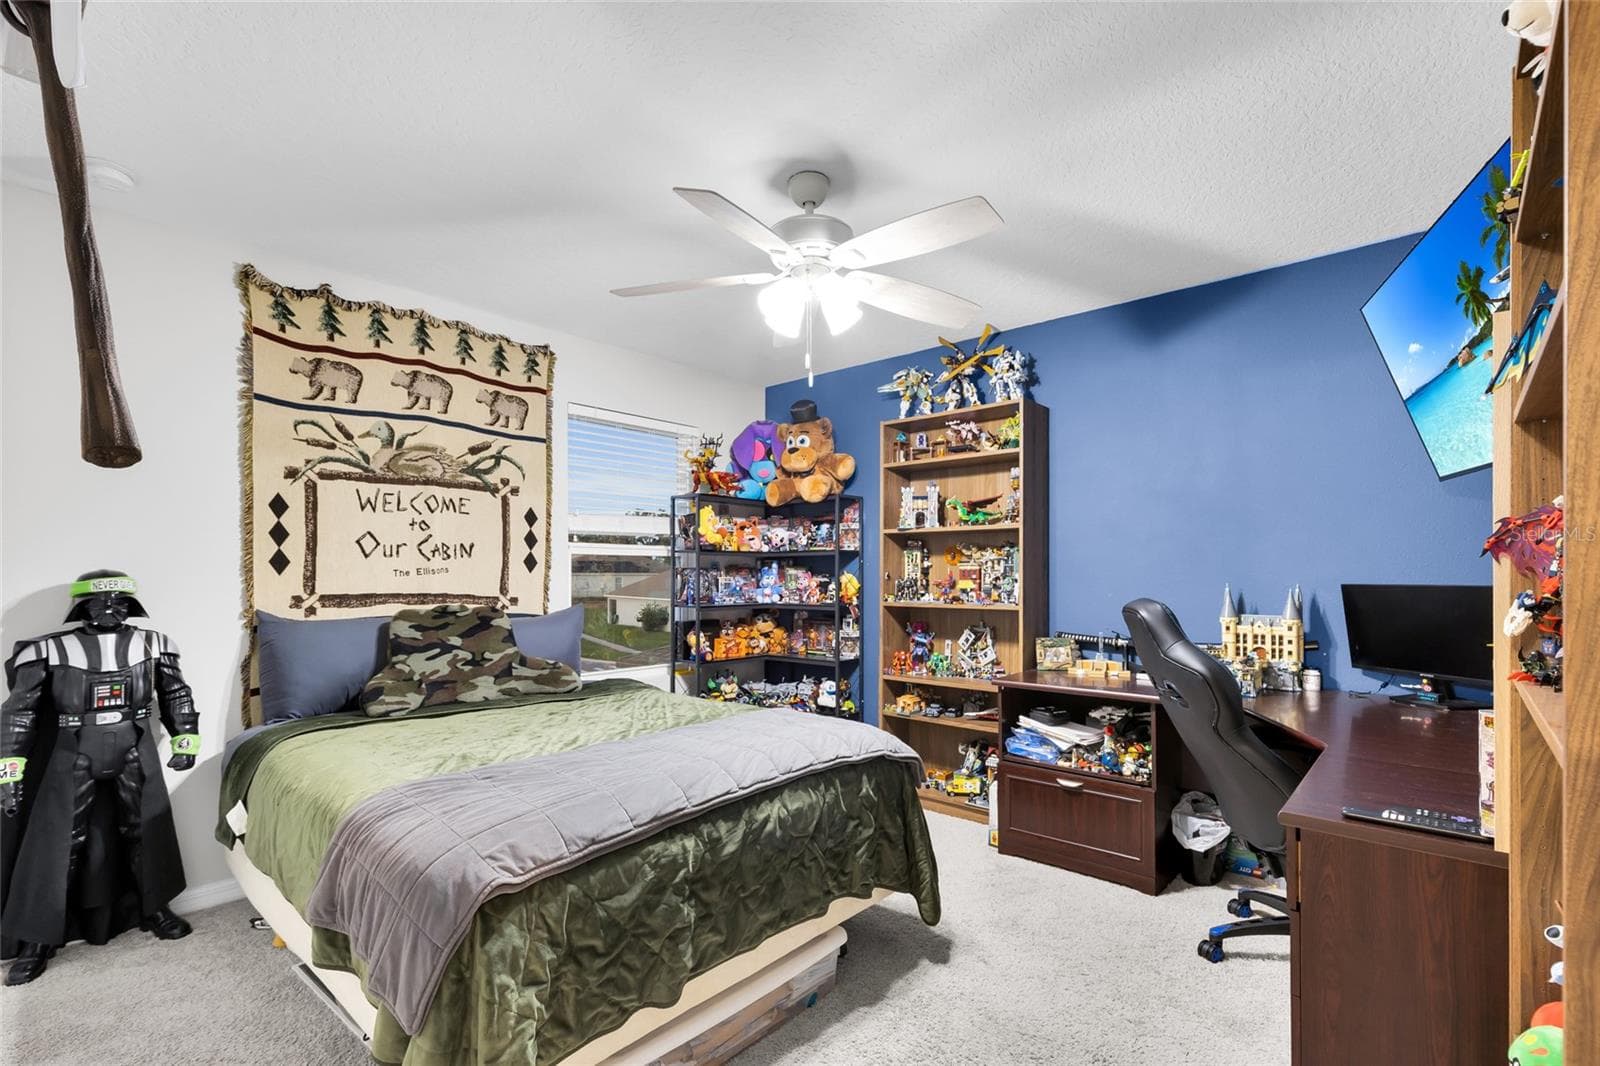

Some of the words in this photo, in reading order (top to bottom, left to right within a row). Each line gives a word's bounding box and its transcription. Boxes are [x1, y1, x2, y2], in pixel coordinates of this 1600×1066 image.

[356, 488, 471, 515] WELCOME
[409, 517, 431, 531] to
[355, 531, 408, 559] Our
[417, 534, 475, 562] CABIN
[393, 569, 410, 577] The
[416, 566, 449, 577] Ellisons
[93, 580, 119, 591] NEVER
